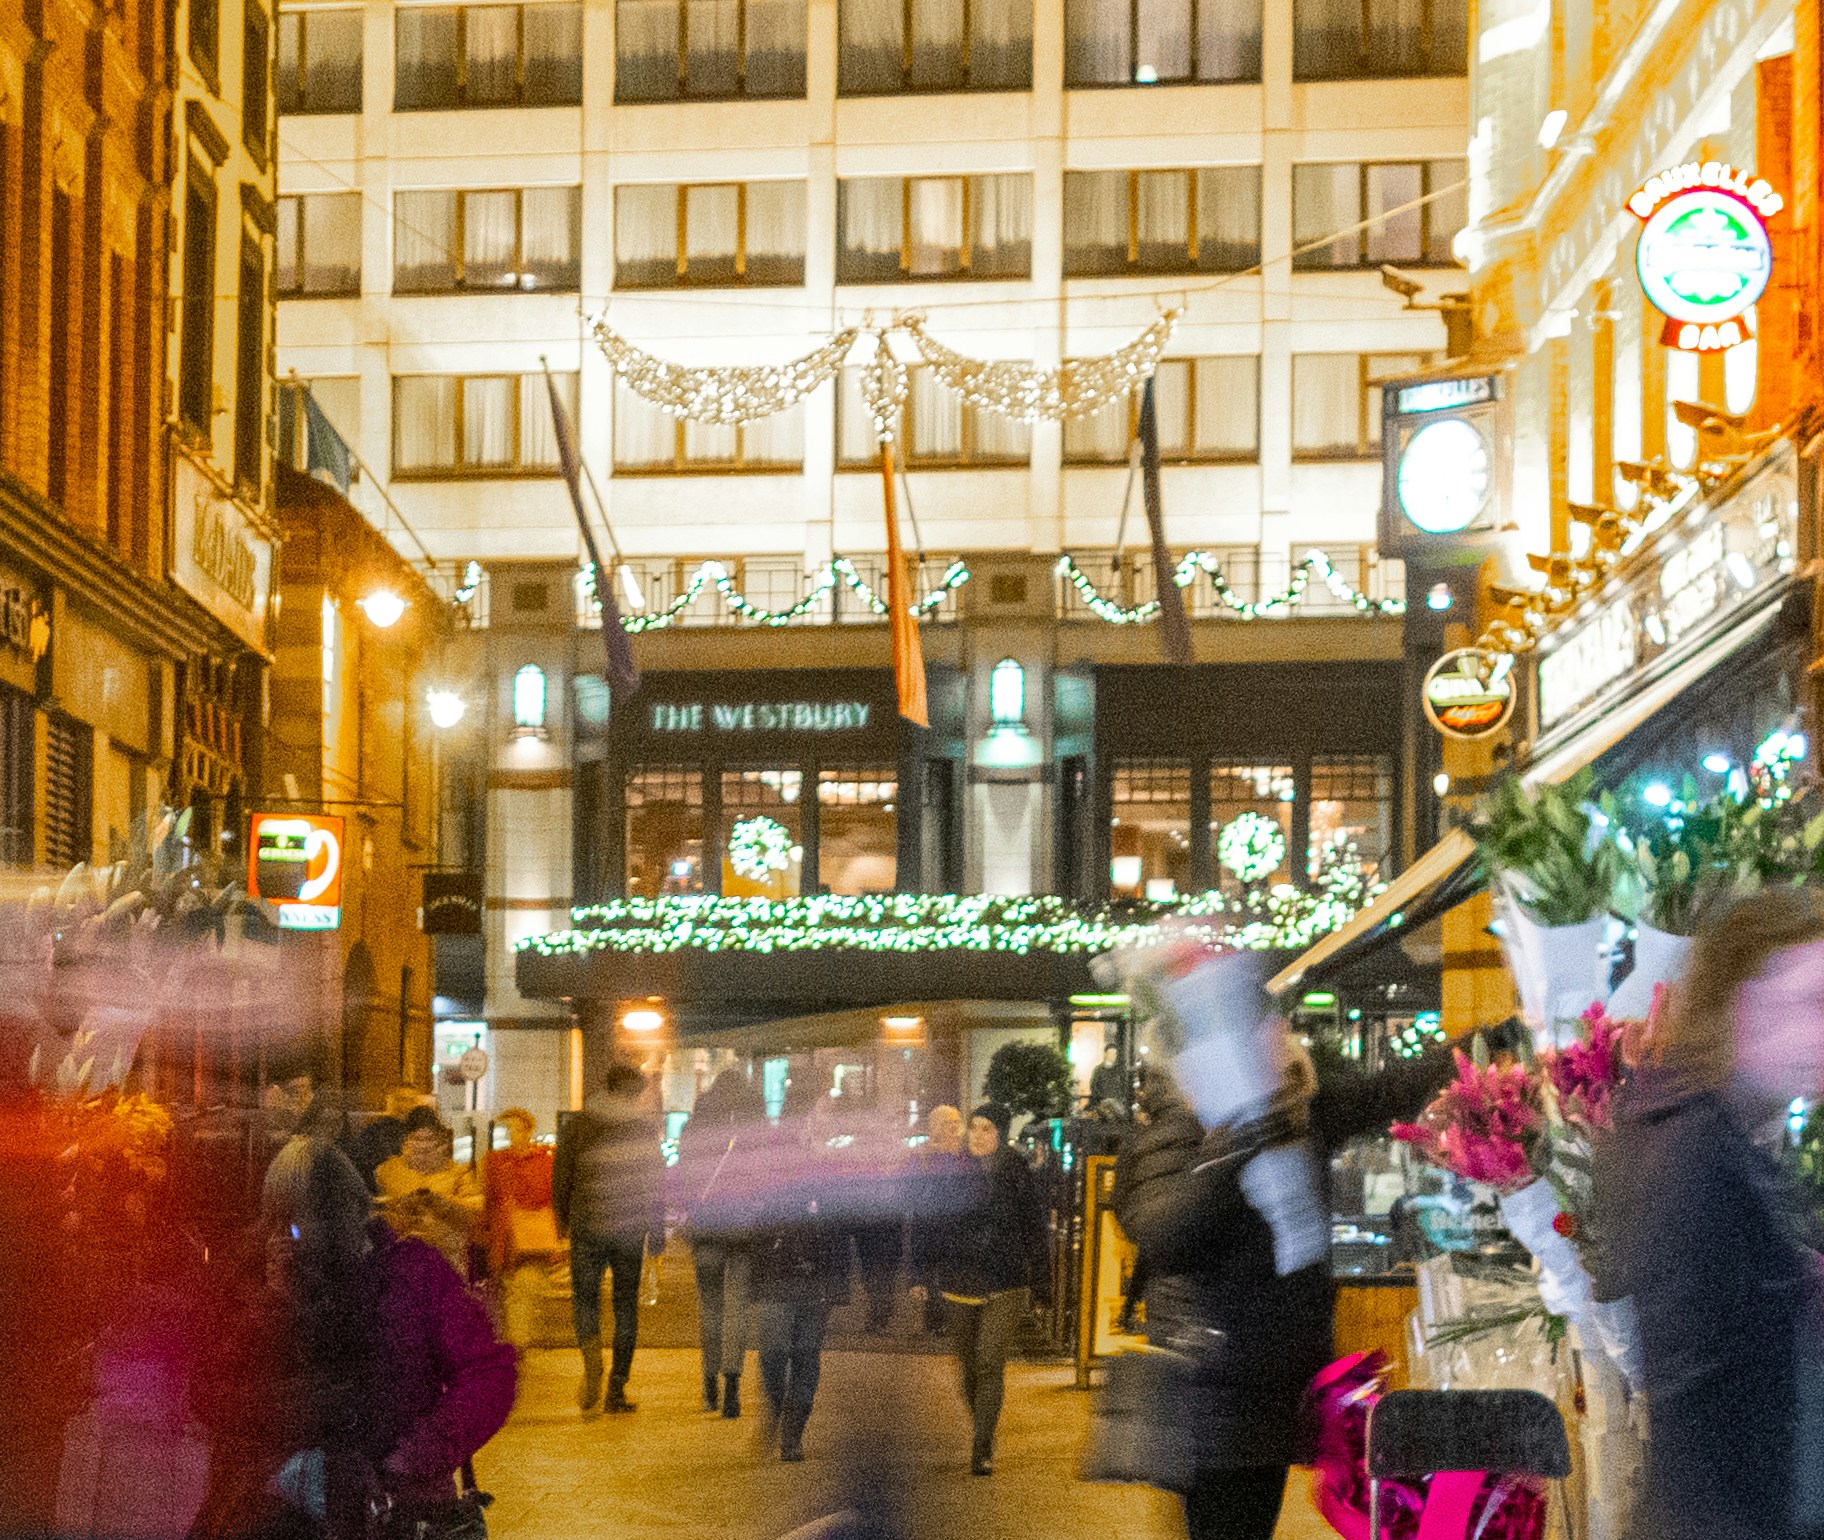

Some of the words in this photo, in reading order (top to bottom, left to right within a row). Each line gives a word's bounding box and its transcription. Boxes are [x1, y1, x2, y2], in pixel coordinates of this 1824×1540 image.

[1629, 161, 1784, 217] BRUXELLES
[1678, 321, 1741, 350] BAR
[652, 703, 703, 731] THE
[712, 701, 869, 731] WESTBURY
